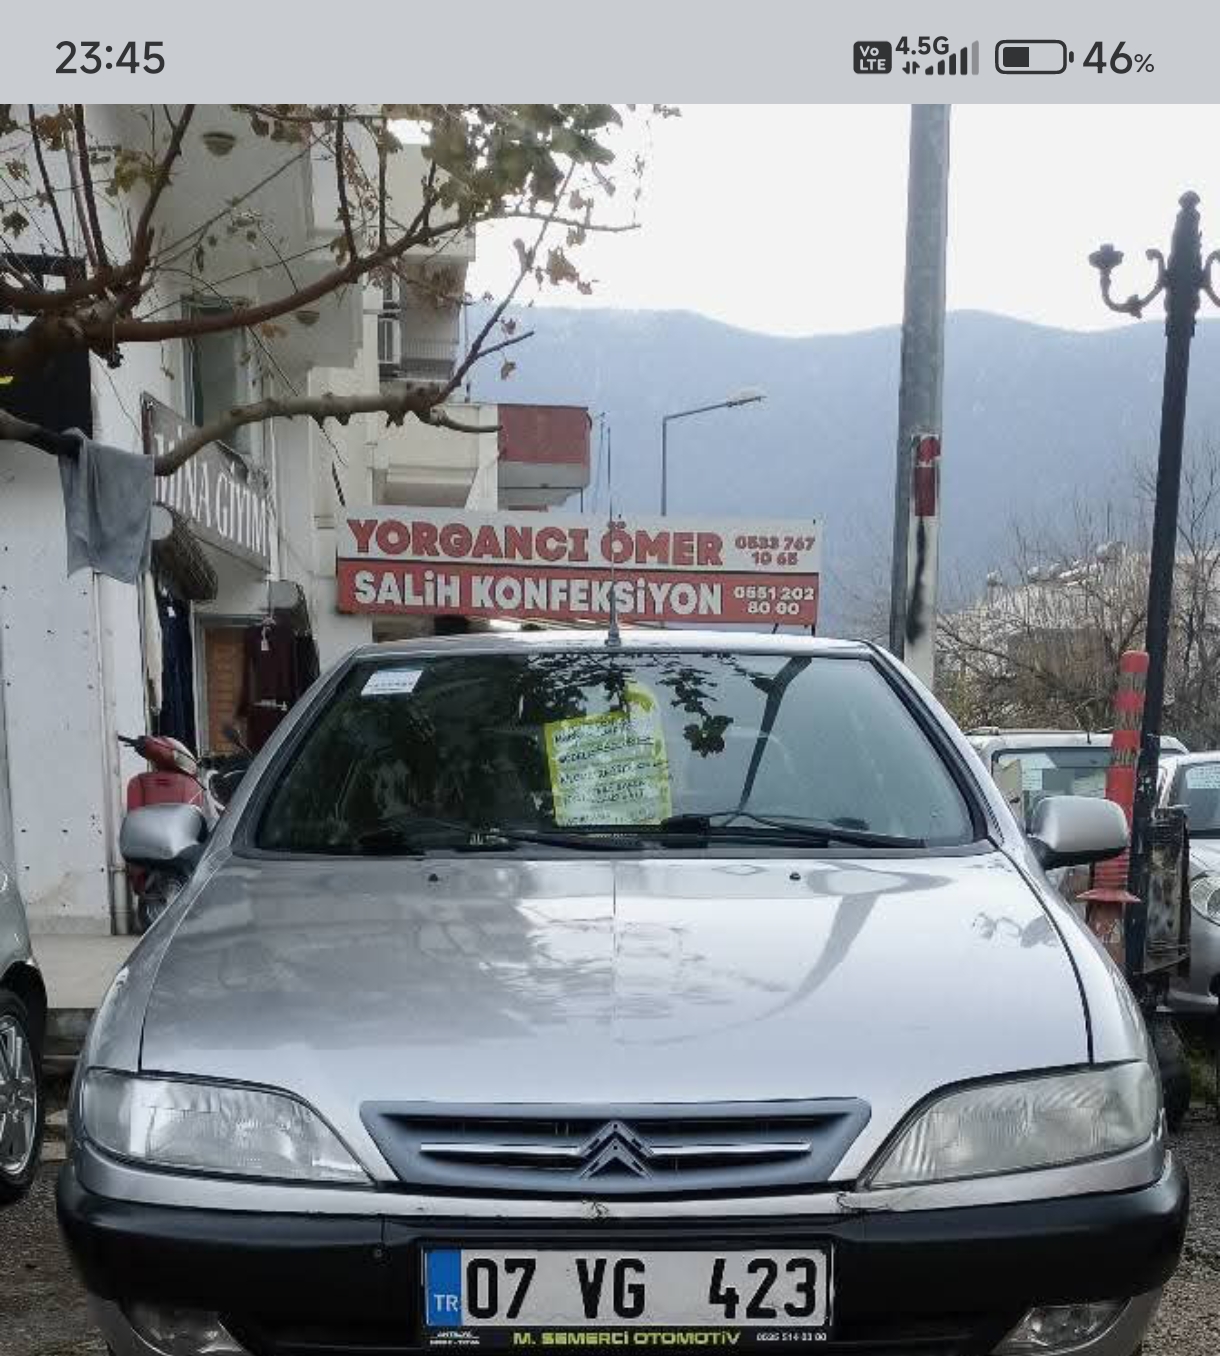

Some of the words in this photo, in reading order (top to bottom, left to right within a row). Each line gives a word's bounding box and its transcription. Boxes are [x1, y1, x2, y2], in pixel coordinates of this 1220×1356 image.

[347, 518, 589, 562] YORGANCI
[601, 521, 723, 565] ÖMER
[752, 551, 772, 565] 10
[354, 569, 460, 607] SALİH
[471, 575, 722, 615] KONFEKSİYON
[781, 587, 815, 600] 202
[747, 601, 770, 614] 80
[466, 1257, 537, 1319] 07
[575, 1257, 646, 1319] VG
[708, 1257, 817, 1319] 423
[433, 1294, 459, 1312] TR
[513, 1332, 536, 1345] M.
[541, 1330, 630, 1345] SEMERCİ
[633, 1330, 741, 1345] OTOMOTİV
